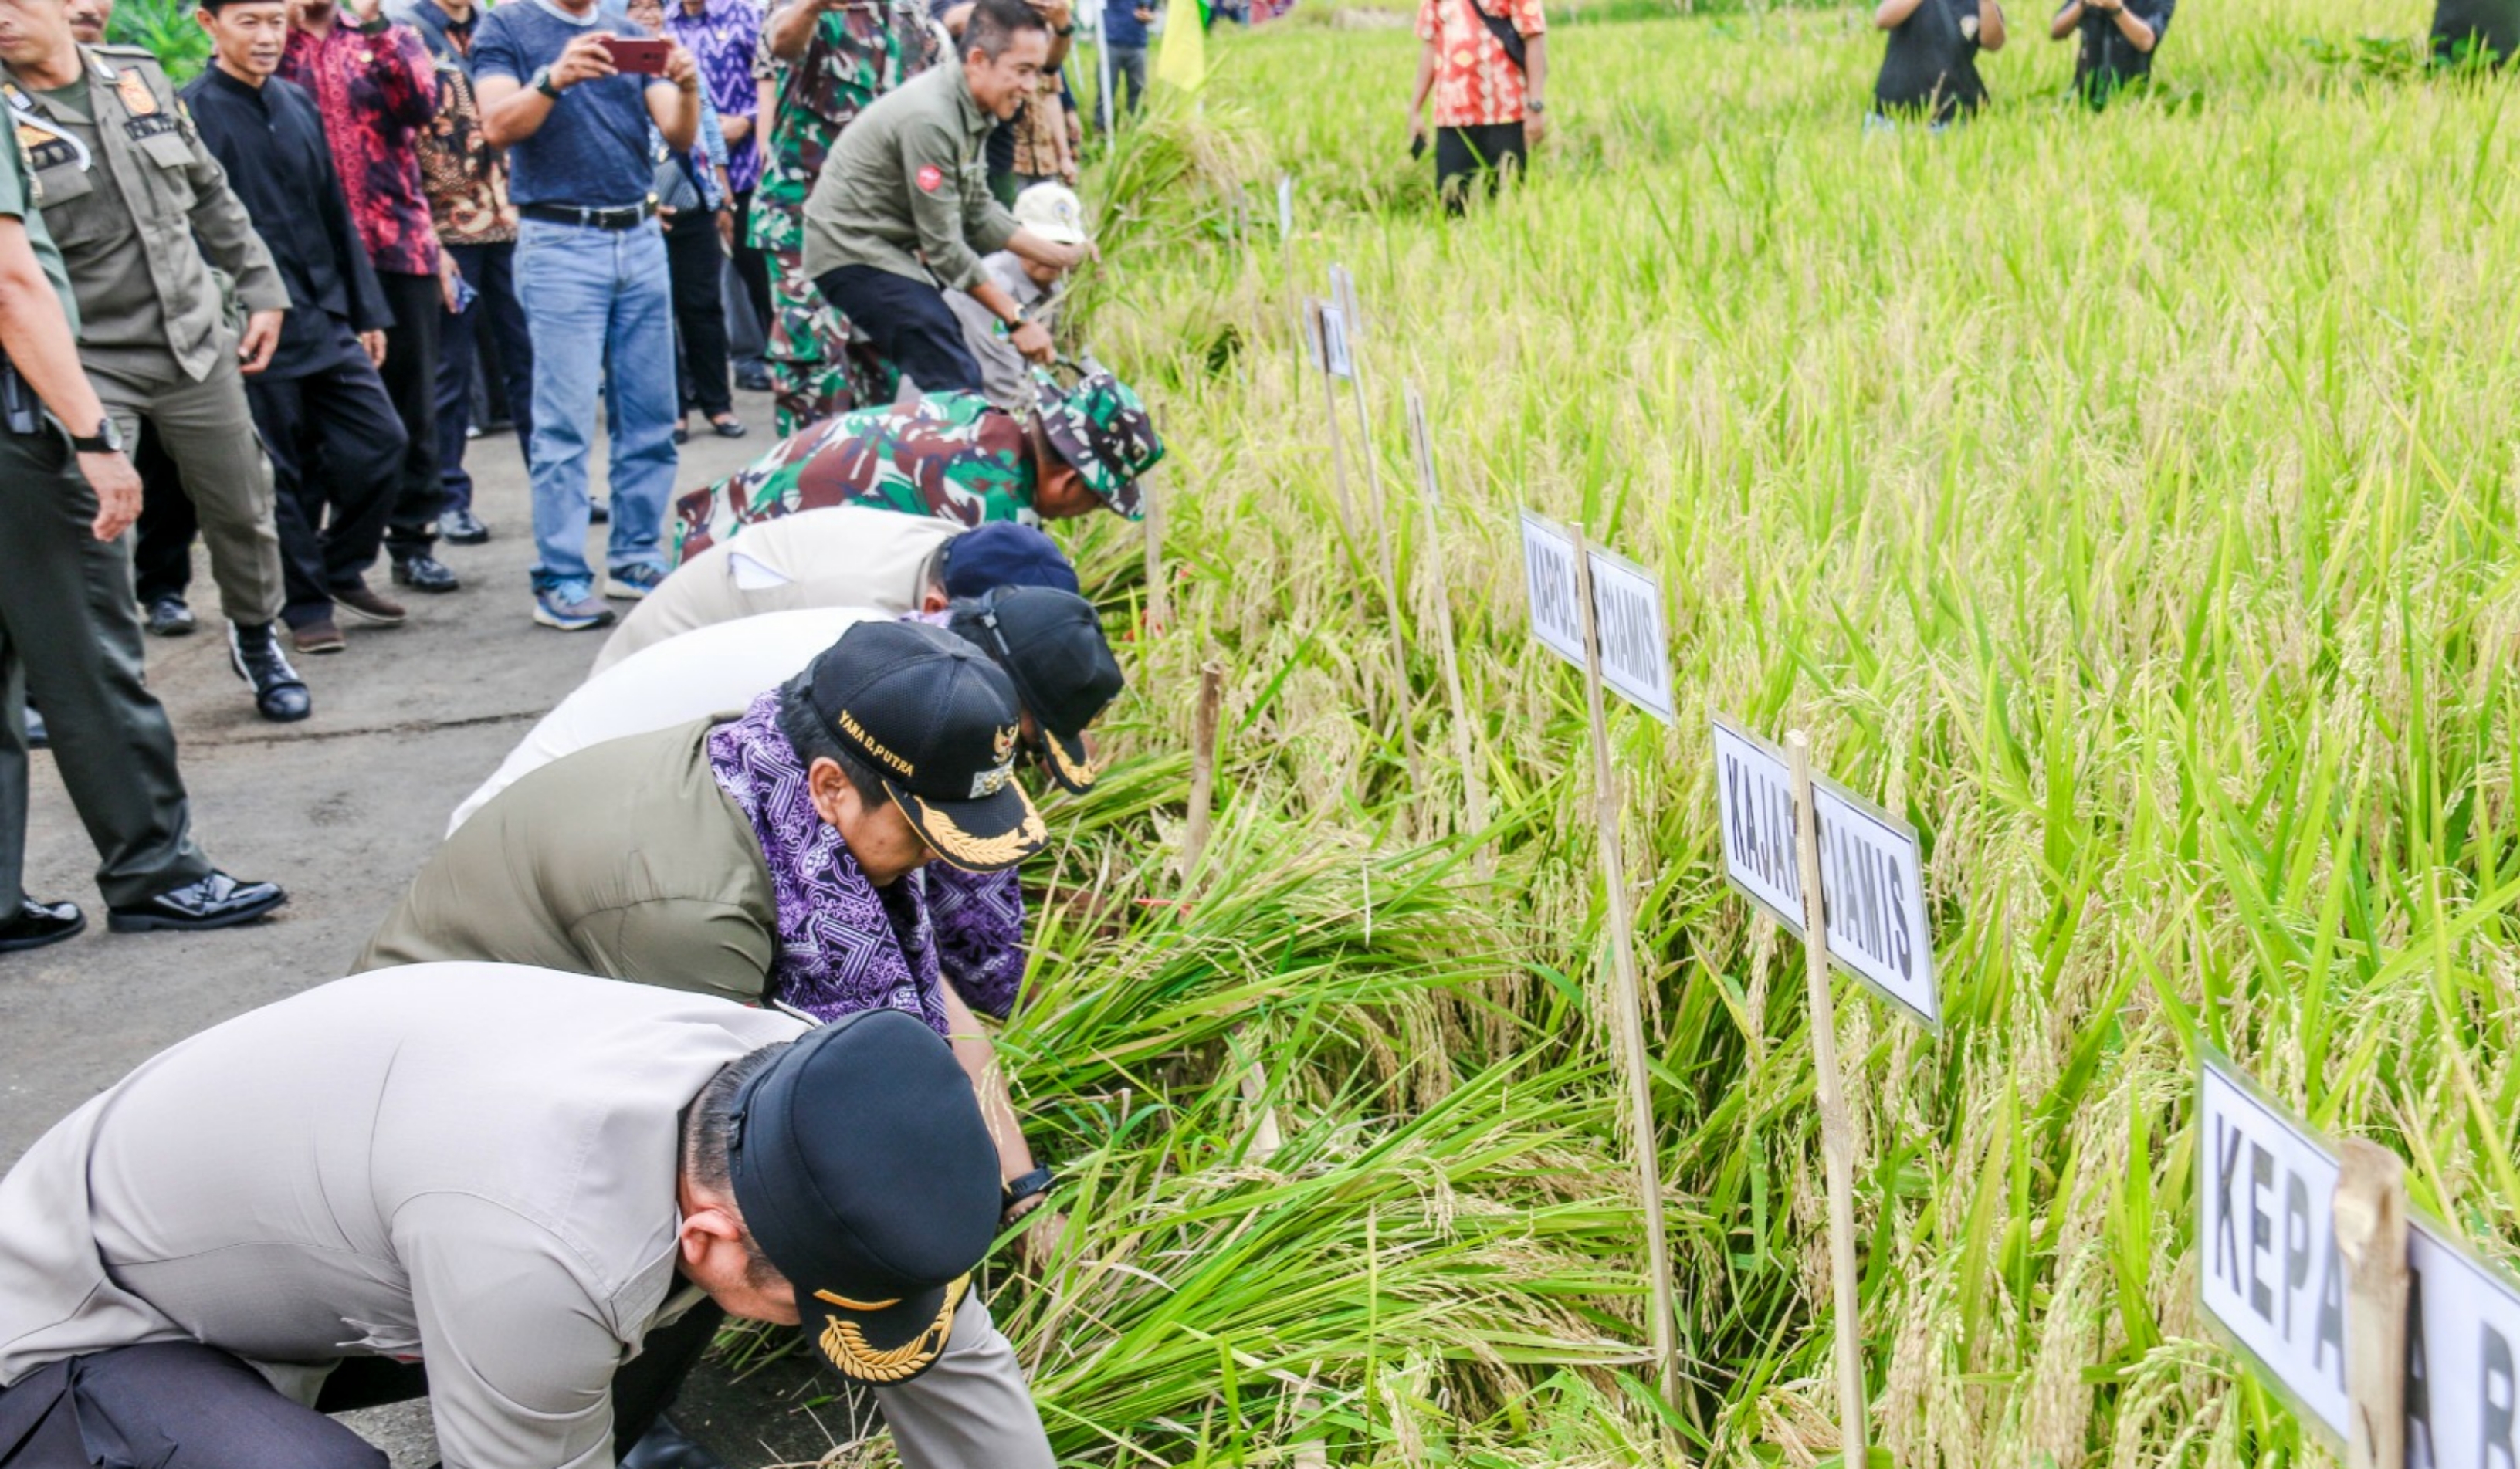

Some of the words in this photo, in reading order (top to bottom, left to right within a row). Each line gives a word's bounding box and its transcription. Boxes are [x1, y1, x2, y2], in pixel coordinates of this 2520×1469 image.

[1600, 570, 1658, 690] CIAMIS
[839, 709, 865, 742] YANA
[1814, 806, 1912, 982] CIAMIS
[2215, 1112, 2437, 1469] KEPAA
